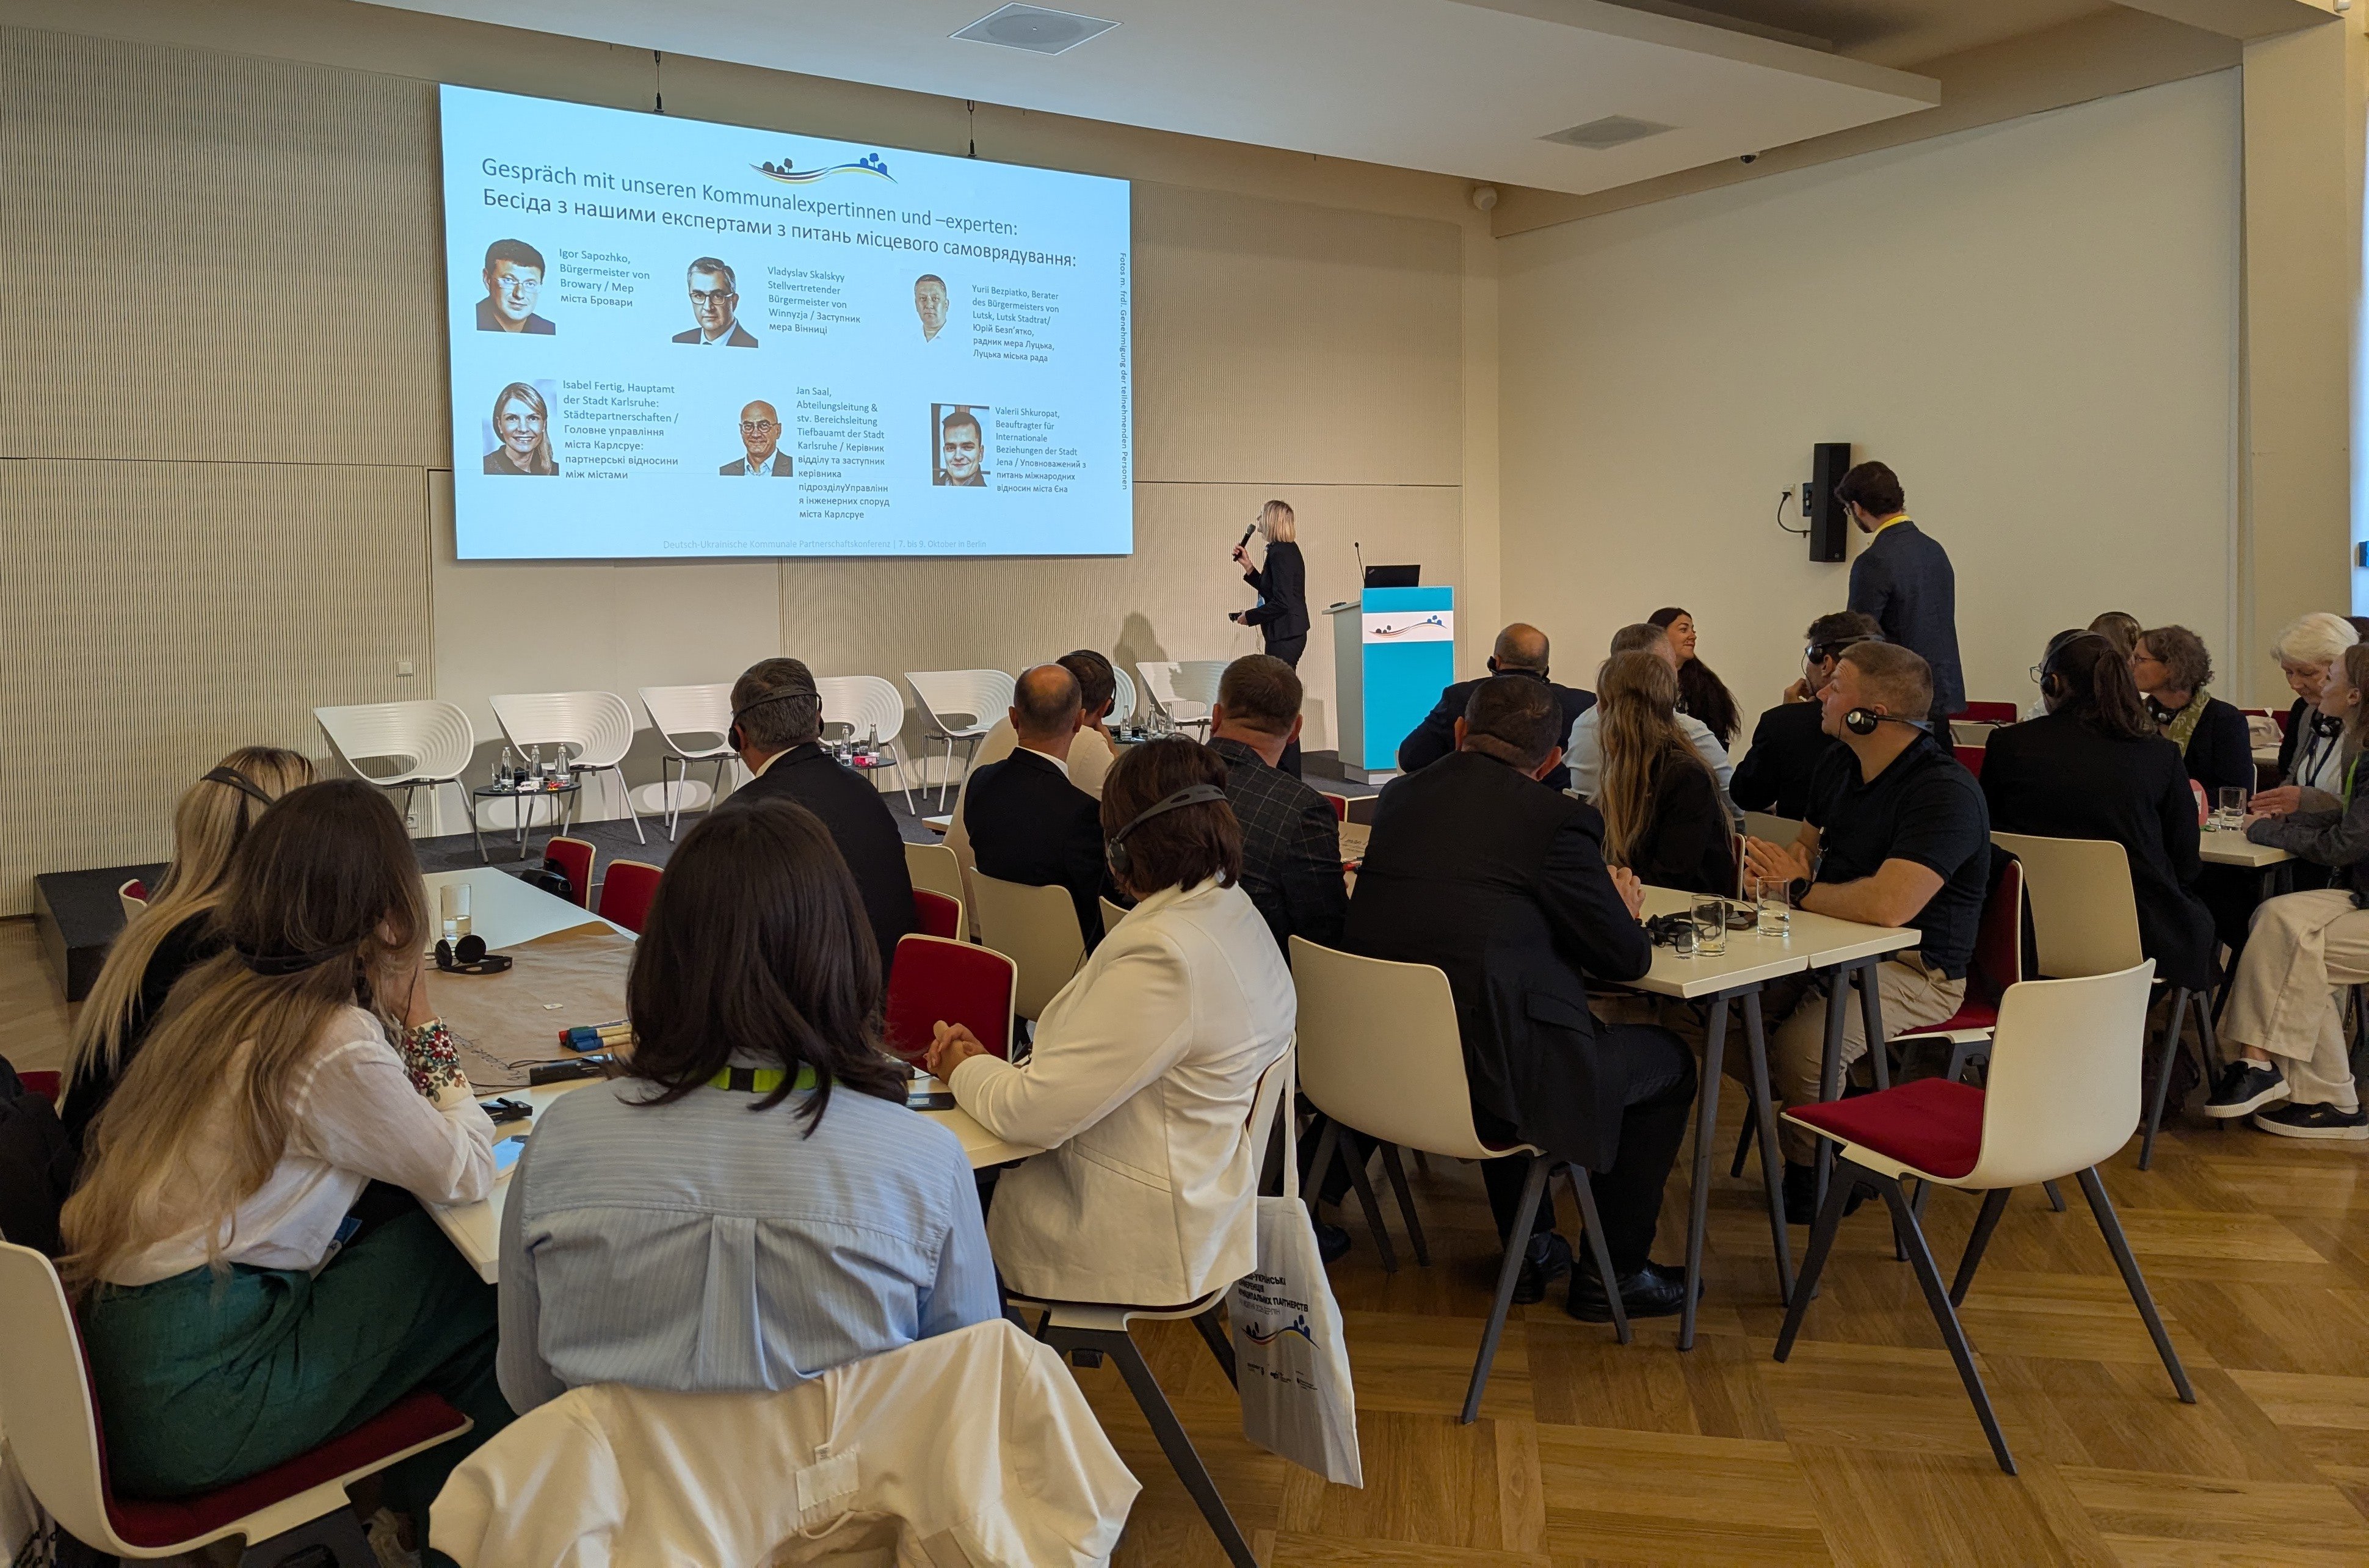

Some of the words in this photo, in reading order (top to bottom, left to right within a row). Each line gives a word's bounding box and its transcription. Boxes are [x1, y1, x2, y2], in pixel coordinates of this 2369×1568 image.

[482, 158, 576, 186] Gespräch
[583, 172, 615, 190] mit
[622, 178, 696, 199] unseren
[703, 184, 896, 222] Kommunalexpertinnen
[902, 209, 931, 226] und
[484, 188, 551, 215] Бесіда
[557, 200, 568, 214] з
[575, 202, 656, 223] нашими
[662, 211, 772, 235] експертами
[777, 224, 786, 237] з
[791, 226, 852, 244] питань
[856, 230, 938, 253] місцевого
[943, 242, 1076, 267] самоврядування:
[559, 248, 579, 260] Igor
[581, 250, 631, 265] Sapozhko,
[559, 263, 630, 278] Bürgermeister
[767, 266, 808, 278] Vladyslav
[810, 270, 845, 283] Skalskyy
[560, 278, 602, 292] Browary
[767, 280, 841, 295] Stellvertretender
[1119, 277, 1125, 288] m.
[991, 286, 1030, 299] Bezpiatko,
[1031, 290, 1059, 300] Berater
[561, 294, 587, 303] міста
[590, 295, 633, 308] Бровари
[768, 294, 830, 307] Bürgermeister
[972, 297, 986, 307] des
[987, 299, 1044, 312] Bürgermeisters
[768, 308, 808, 321] Winnyzja
[816, 311, 861, 324] Заступник
[973, 310, 995, 321] Lutsk,
[996, 313, 1017, 322] Lutsk
[769, 324, 793, 333] мера
[794, 324, 827, 336] Вінниці
[973, 323, 993, 334] Юрій
[973, 338, 1002, 347] радник
[1003, 340, 1024, 349] мера
[1025, 340, 1054, 351] Луцька,
[1119, 310, 1128, 368] Genehmigung
[973, 349, 1001, 360] Луцька
[1003, 352, 1028, 360] міська
[1029, 355, 1048, 363] рада
[563, 380, 592, 390] Isabel
[594, 381, 625, 393] Fertig,
[628, 383, 675, 394] Hauptamt
[796, 386, 810, 395] Jan
[812, 387, 832, 397] Saal,
[563, 394, 580, 405] der
[582, 396, 609, 406] Stadt
[611, 397, 659, 408] Karlsruhe:
[796, 399, 869, 414] Abteilungsleitung
[564, 410, 672, 423] Städtepartnerschaften
[995, 406, 1019, 416] Valerii
[1020, 407, 1060, 419] Shkuropat,
[814, 415, 878, 427] Bereichsleitung
[995, 419, 1042, 431] Beauftragter
[1043, 421, 1054, 430] für
[564, 424, 607, 435] Головне
[608, 427, 664, 437] управління
[797, 427, 846, 438] Tiefbauamt
[847, 429, 862, 438] der
[863, 430, 885, 439] Stadt
[996, 432, 1048, 443] Internationale
[564, 440, 591, 449] міста
[594, 440, 644, 452] Карлсруе:
[797, 441, 838, 451] Karlsruhe
[846, 443, 885, 453] Керівник
[996, 445, 1043, 456] Beziehungen
[1045, 446, 1058, 456] der
[1059, 448, 1078, 456] Stadt
[565, 456, 625, 466] партнерські
[628, 456, 678, 466] відносини
[798, 455, 830, 466] відділу
[842, 458, 885, 466] заступник
[1020, 459, 1081, 468] Уповноважений
[565, 470, 585, 479] між
[587, 470, 628, 479] містами
[798, 469, 842, 479] керівника
[1025, 471, 1075, 482] міжнародних
[996, 484, 1031, 493] відносин
[1032, 484, 1053, 493] міста
[806, 496, 858, 507] інженерних
[859, 499, 890, 507] споруд
[799, 509, 822, 518] міста
[824, 510, 865, 520] Карлсруе
[663, 540, 748, 549] Deutsch-Ukrainische
[750, 539, 797, 548] Kommunale
[799, 539, 891, 548] Partnerschaftskonferenz
[907, 540, 918, 548] bis
[967, 540, 987, 548] Berlin
